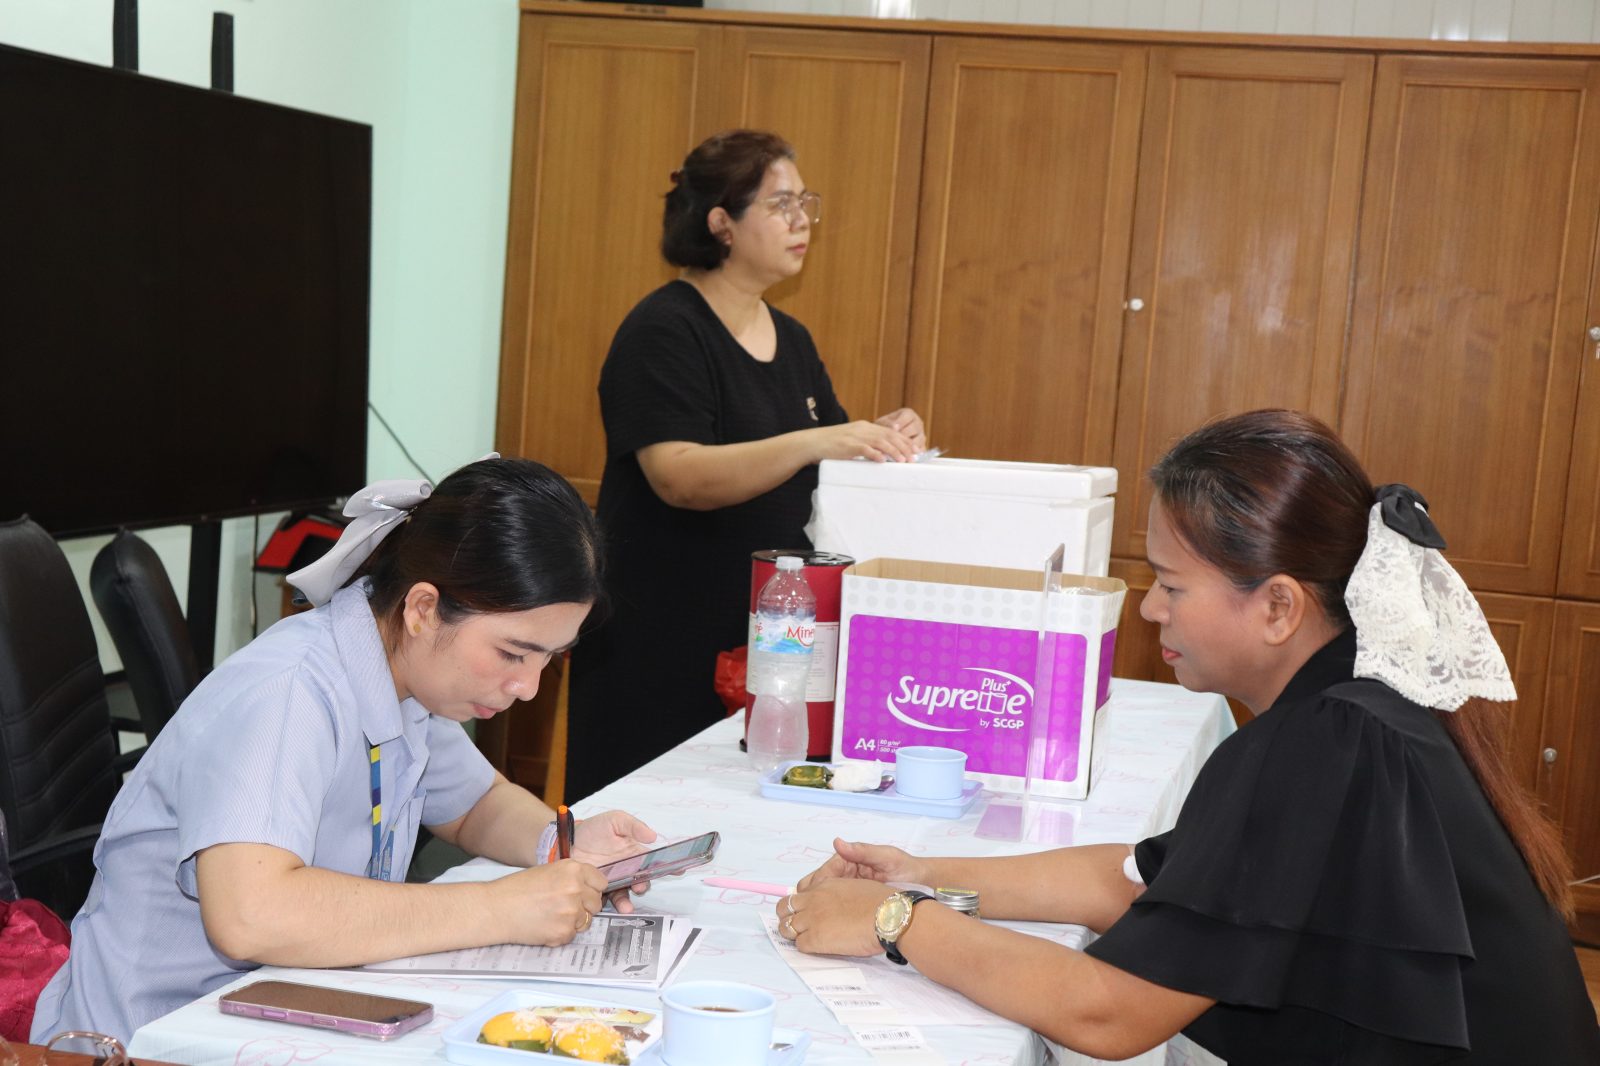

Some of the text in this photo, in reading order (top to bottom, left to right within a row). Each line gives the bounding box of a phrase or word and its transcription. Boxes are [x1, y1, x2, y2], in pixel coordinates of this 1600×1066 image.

[980, 718, 1025, 729] by SCGP
[854, 737, 876, 751] A4
